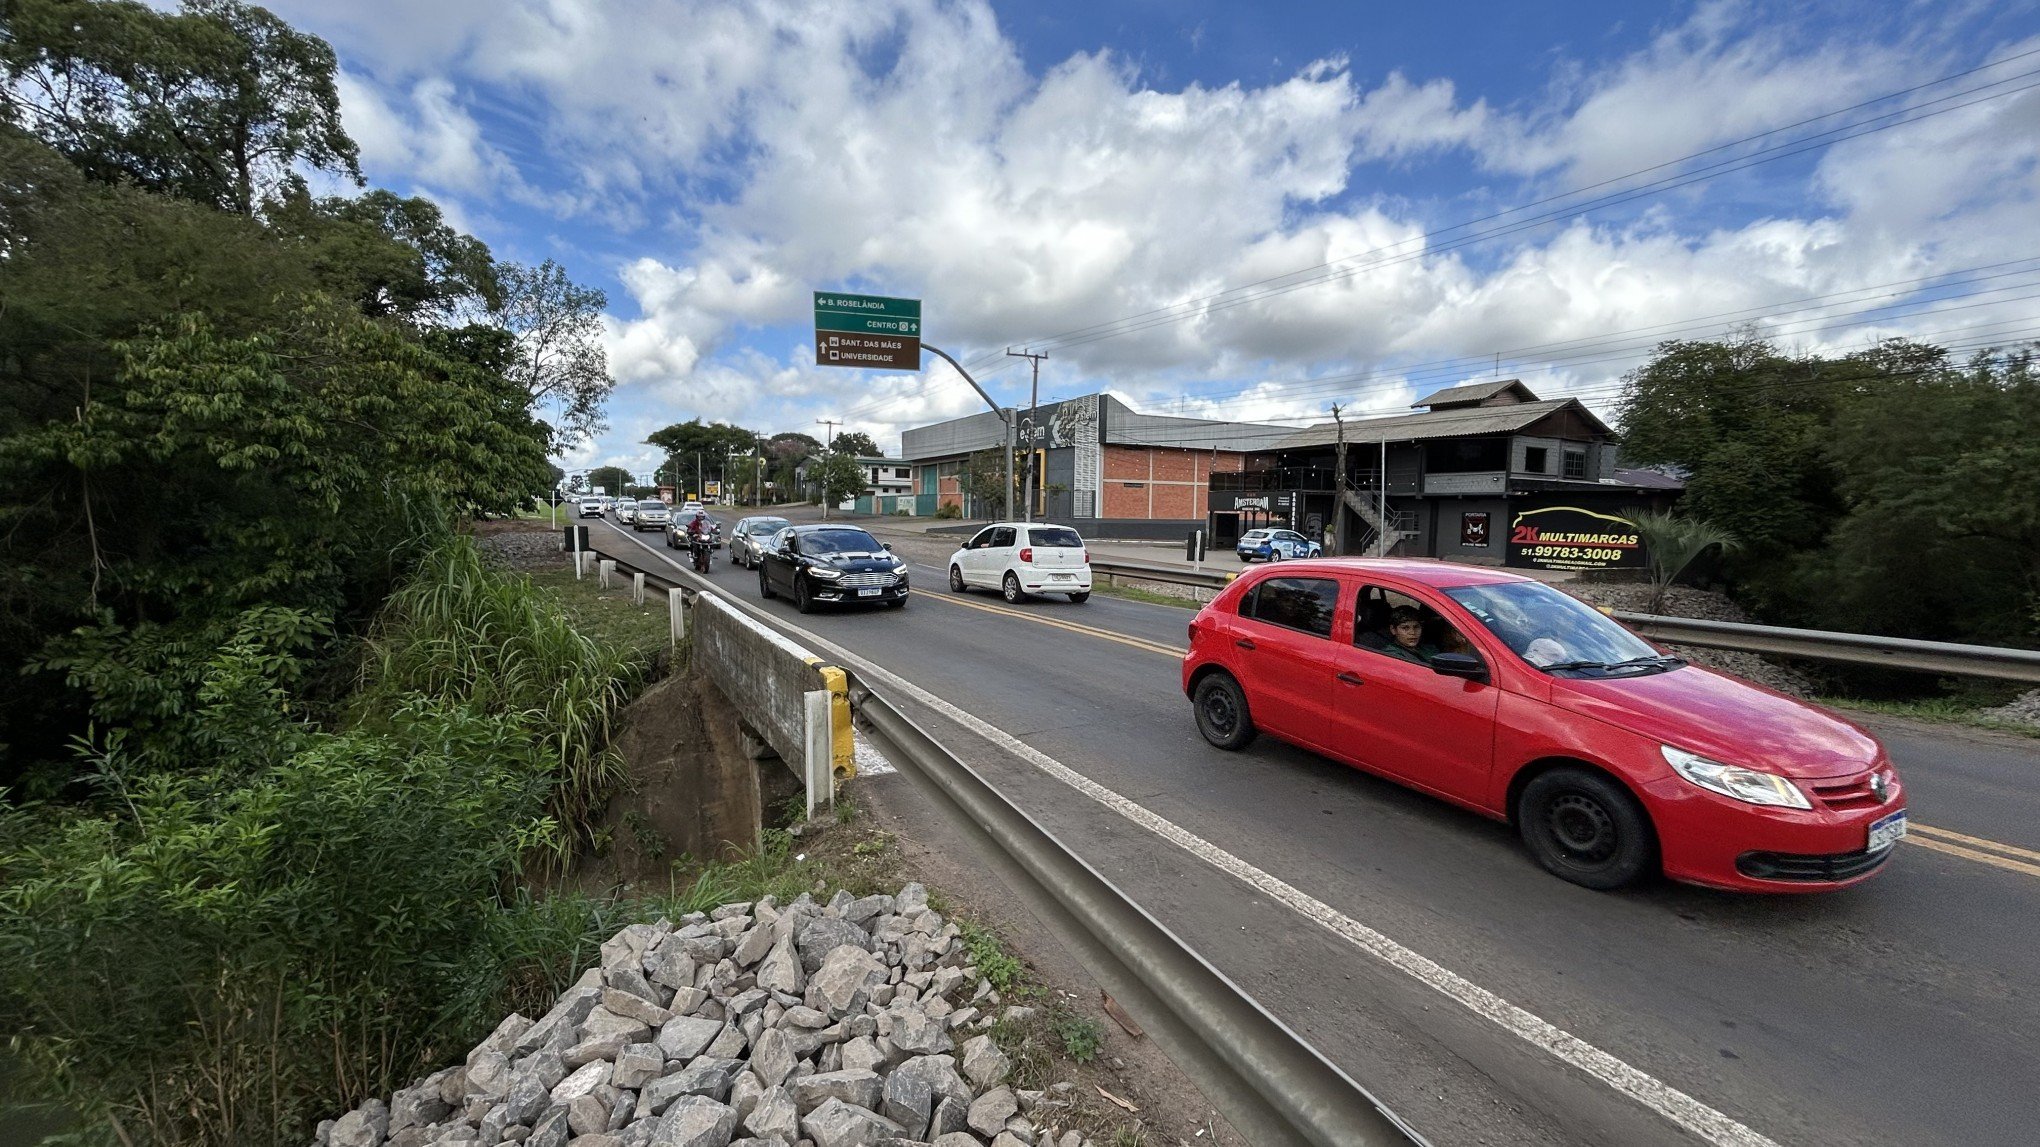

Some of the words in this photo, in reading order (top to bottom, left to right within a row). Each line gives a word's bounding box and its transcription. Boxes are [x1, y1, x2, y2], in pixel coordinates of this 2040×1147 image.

[837, 300, 885, 310] ROSELÂNDIA
[867, 321, 897, 329] CENTRO
[841, 339, 862, 347] SANT.
[881, 341, 902, 349] MÃES
[841, 352, 893, 362] UNIVERSIDADE
[1234, 496, 1269, 511] AMSTERDAM
[1512, 525, 1539, 541] 2K
[1539, 532, 1638, 545] MULTIMARCAS
[1521, 546, 1622, 561] 51.99783-3008
